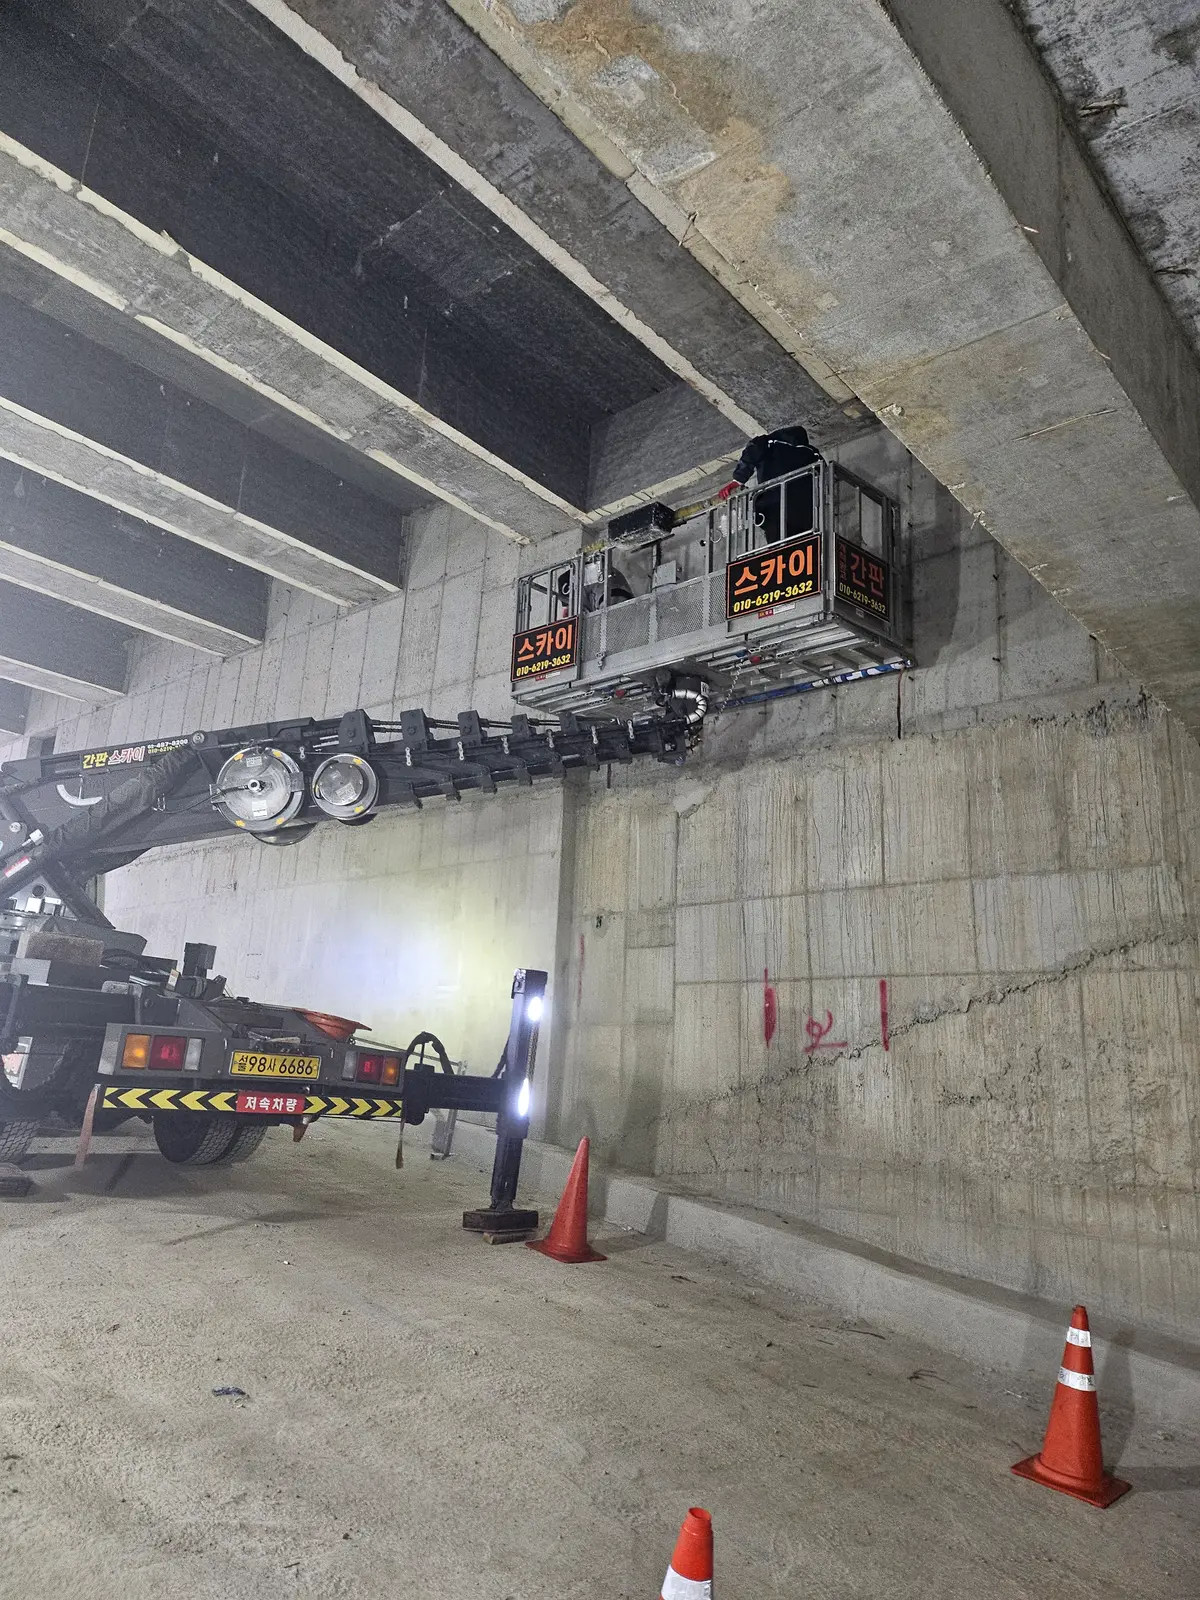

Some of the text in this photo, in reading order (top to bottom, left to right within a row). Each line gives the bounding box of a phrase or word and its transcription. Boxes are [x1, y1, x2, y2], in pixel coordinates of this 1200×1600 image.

[734, 545, 813, 596] 스카이
[850, 552, 884, 598] 간판
[733, 580, 813, 612] 010-6219-3632
[839, 582, 886, 614] 010-6219-3632
[517, 624, 573, 662] 스카이
[516, 653, 571, 677] 010-6219-3632
[82, 746, 146, 769] 간판 스카이
[245, 1096, 298, 1112] 저속차량
